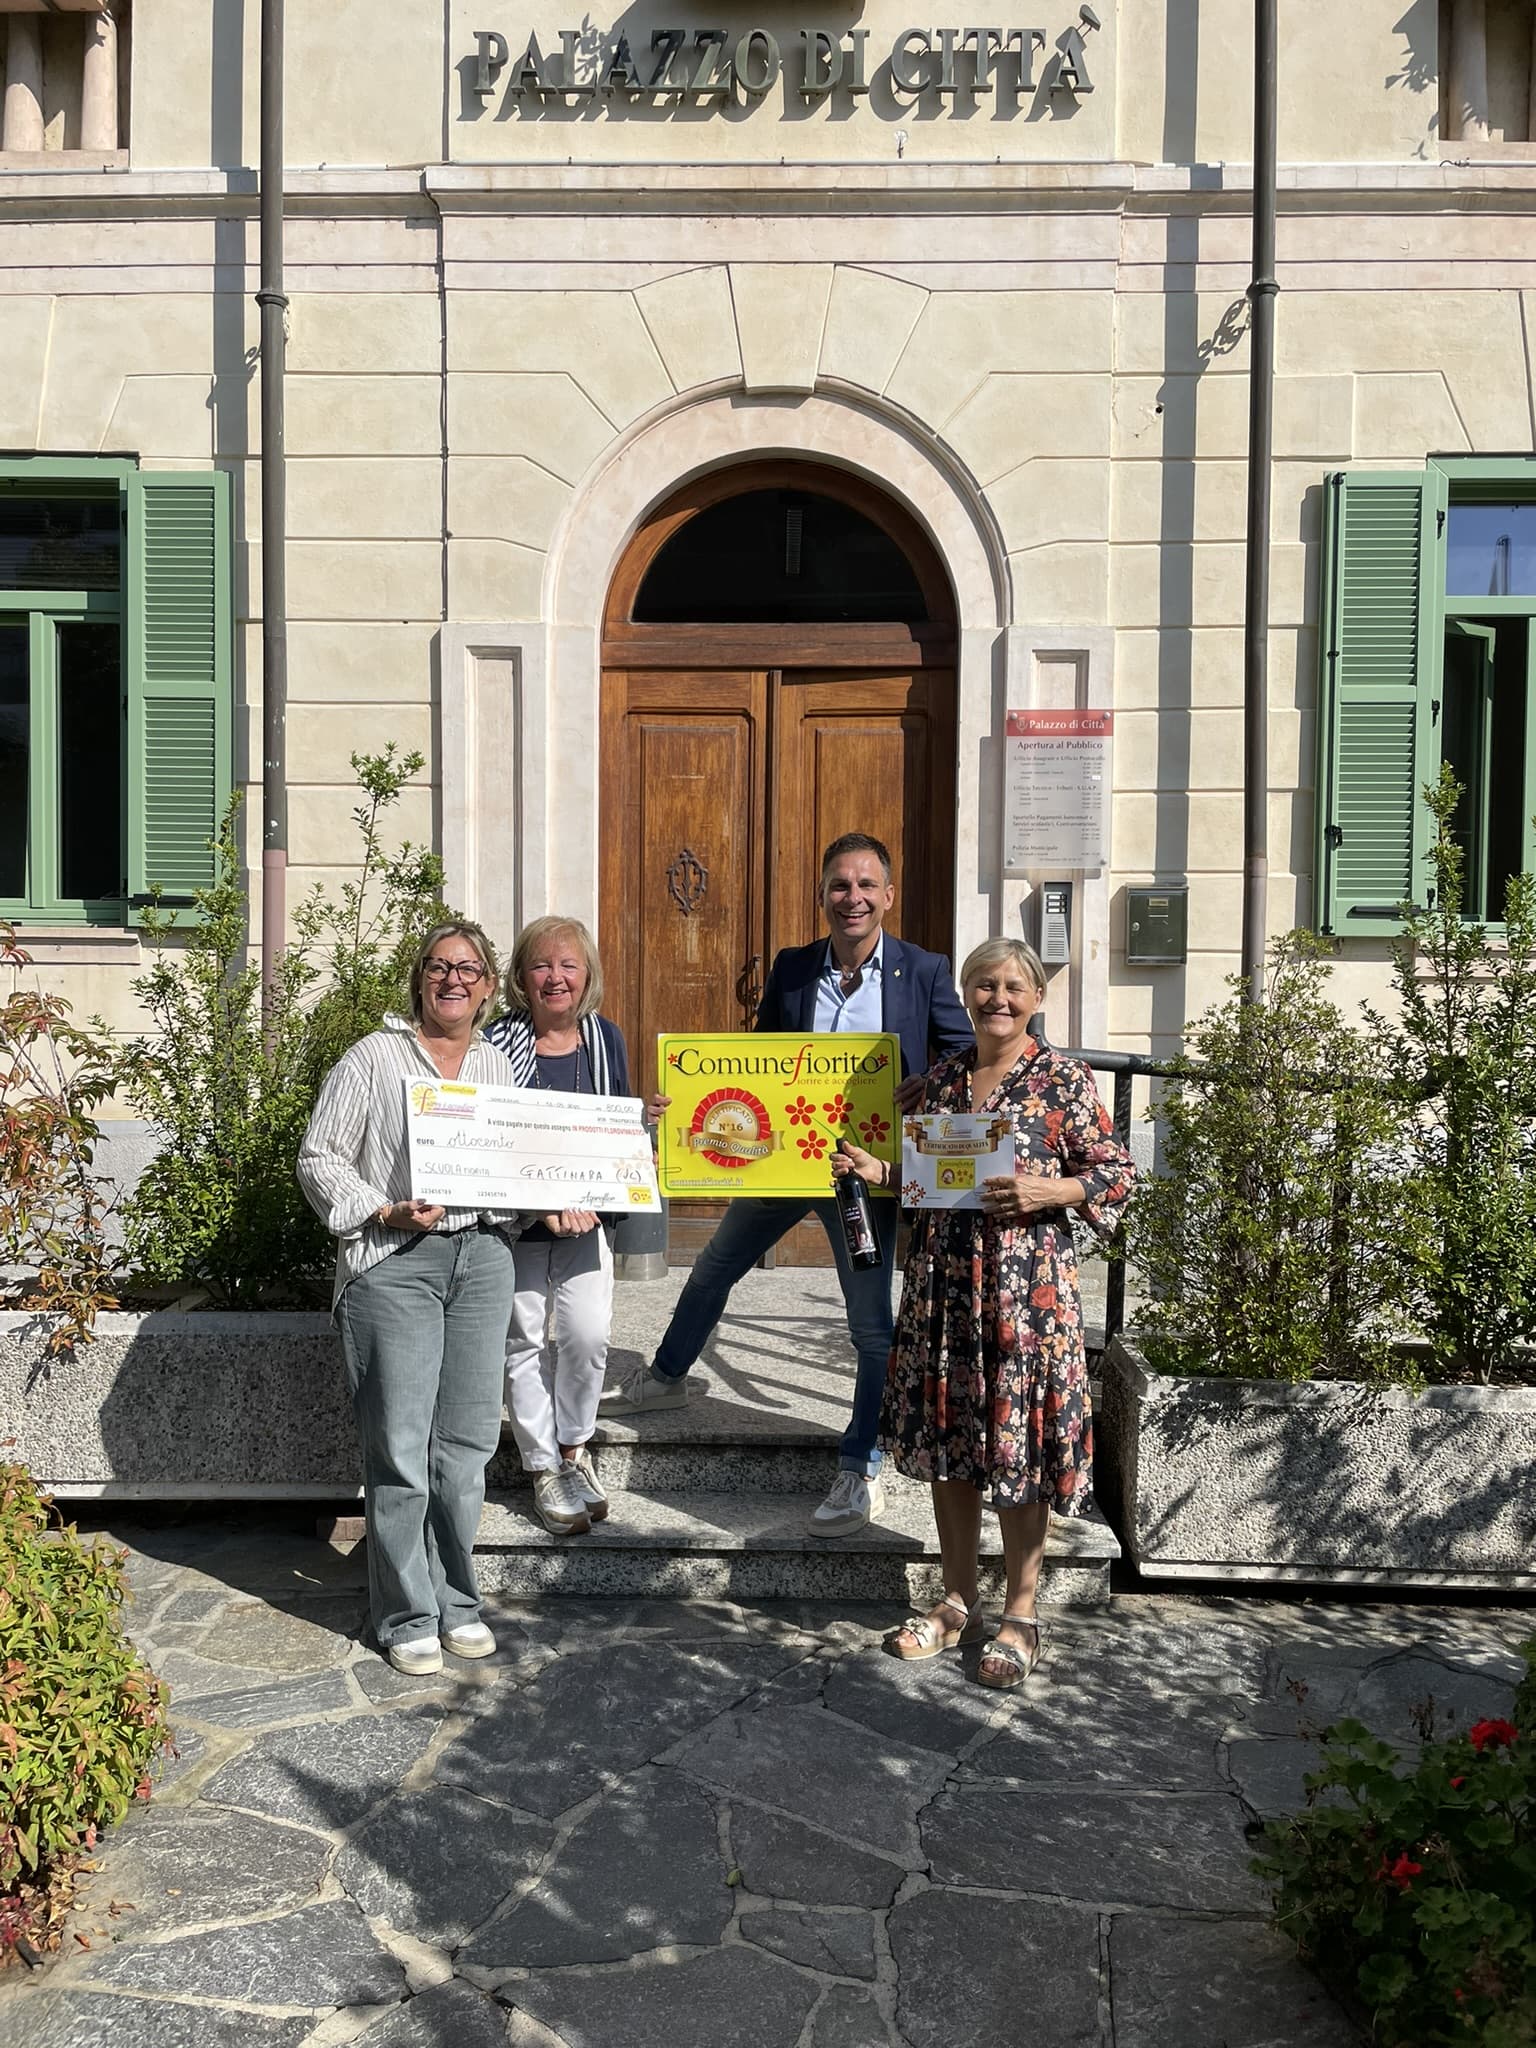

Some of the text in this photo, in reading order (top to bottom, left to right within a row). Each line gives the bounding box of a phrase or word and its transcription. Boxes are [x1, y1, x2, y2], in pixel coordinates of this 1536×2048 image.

[473, 4, 1101, 96] PALAZZO DI CITTÀ
[1029, 719, 1105, 729] Palazzo di Città
[1017, 741, 1103, 751] Apertura al Pubblico
[671, 1044, 888, 1087] Comunefiorito
[832, 1076, 877, 1087] accogliere
[709, 1105, 753, 1125] CERTIFICATO
[492, 1119, 505, 1127] vista
[506, 1120, 523, 1129] pagate
[416, 1137, 435, 1146] euro
[446, 1129, 514, 1149] ottocento
[730, 1142, 769, 1156] Qualità
[424, 1161, 462, 1175] SCUOLA
[519, 1164, 603, 1181] GATTINARA
